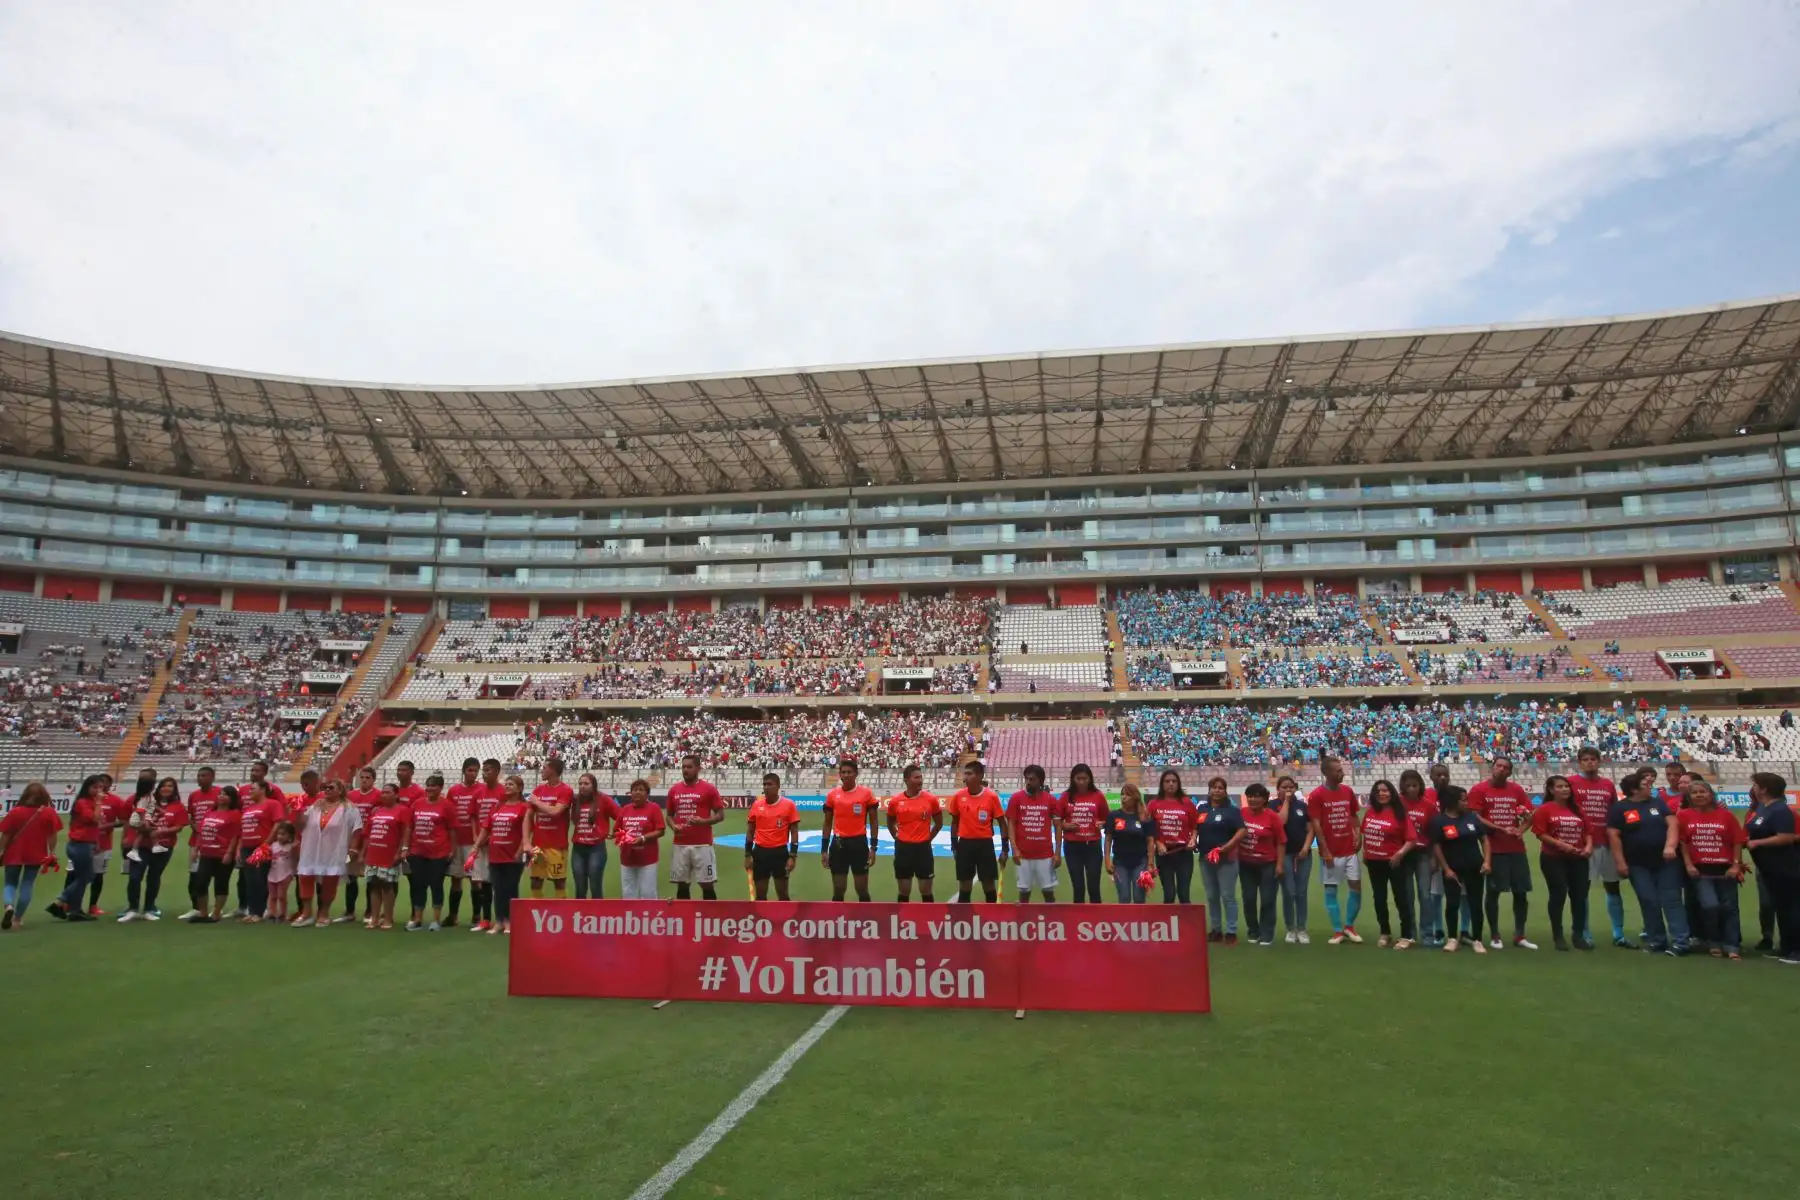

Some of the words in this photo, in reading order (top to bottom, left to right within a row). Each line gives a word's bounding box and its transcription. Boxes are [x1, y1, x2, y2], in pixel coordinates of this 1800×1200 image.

[722, 796, 752, 808] STAL
[707, 864, 713, 876] 6
[532, 908, 563, 934] Yo
[572, 911, 684, 936] también
[692, 912, 773, 944] juego
[783, 914, 880, 940] contra
[890, 914, 918, 940] la
[928, 914, 1066, 942] violencia
[1077, 915, 1180, 942] sexual
[698, 956, 986, 999] #YoTambién
